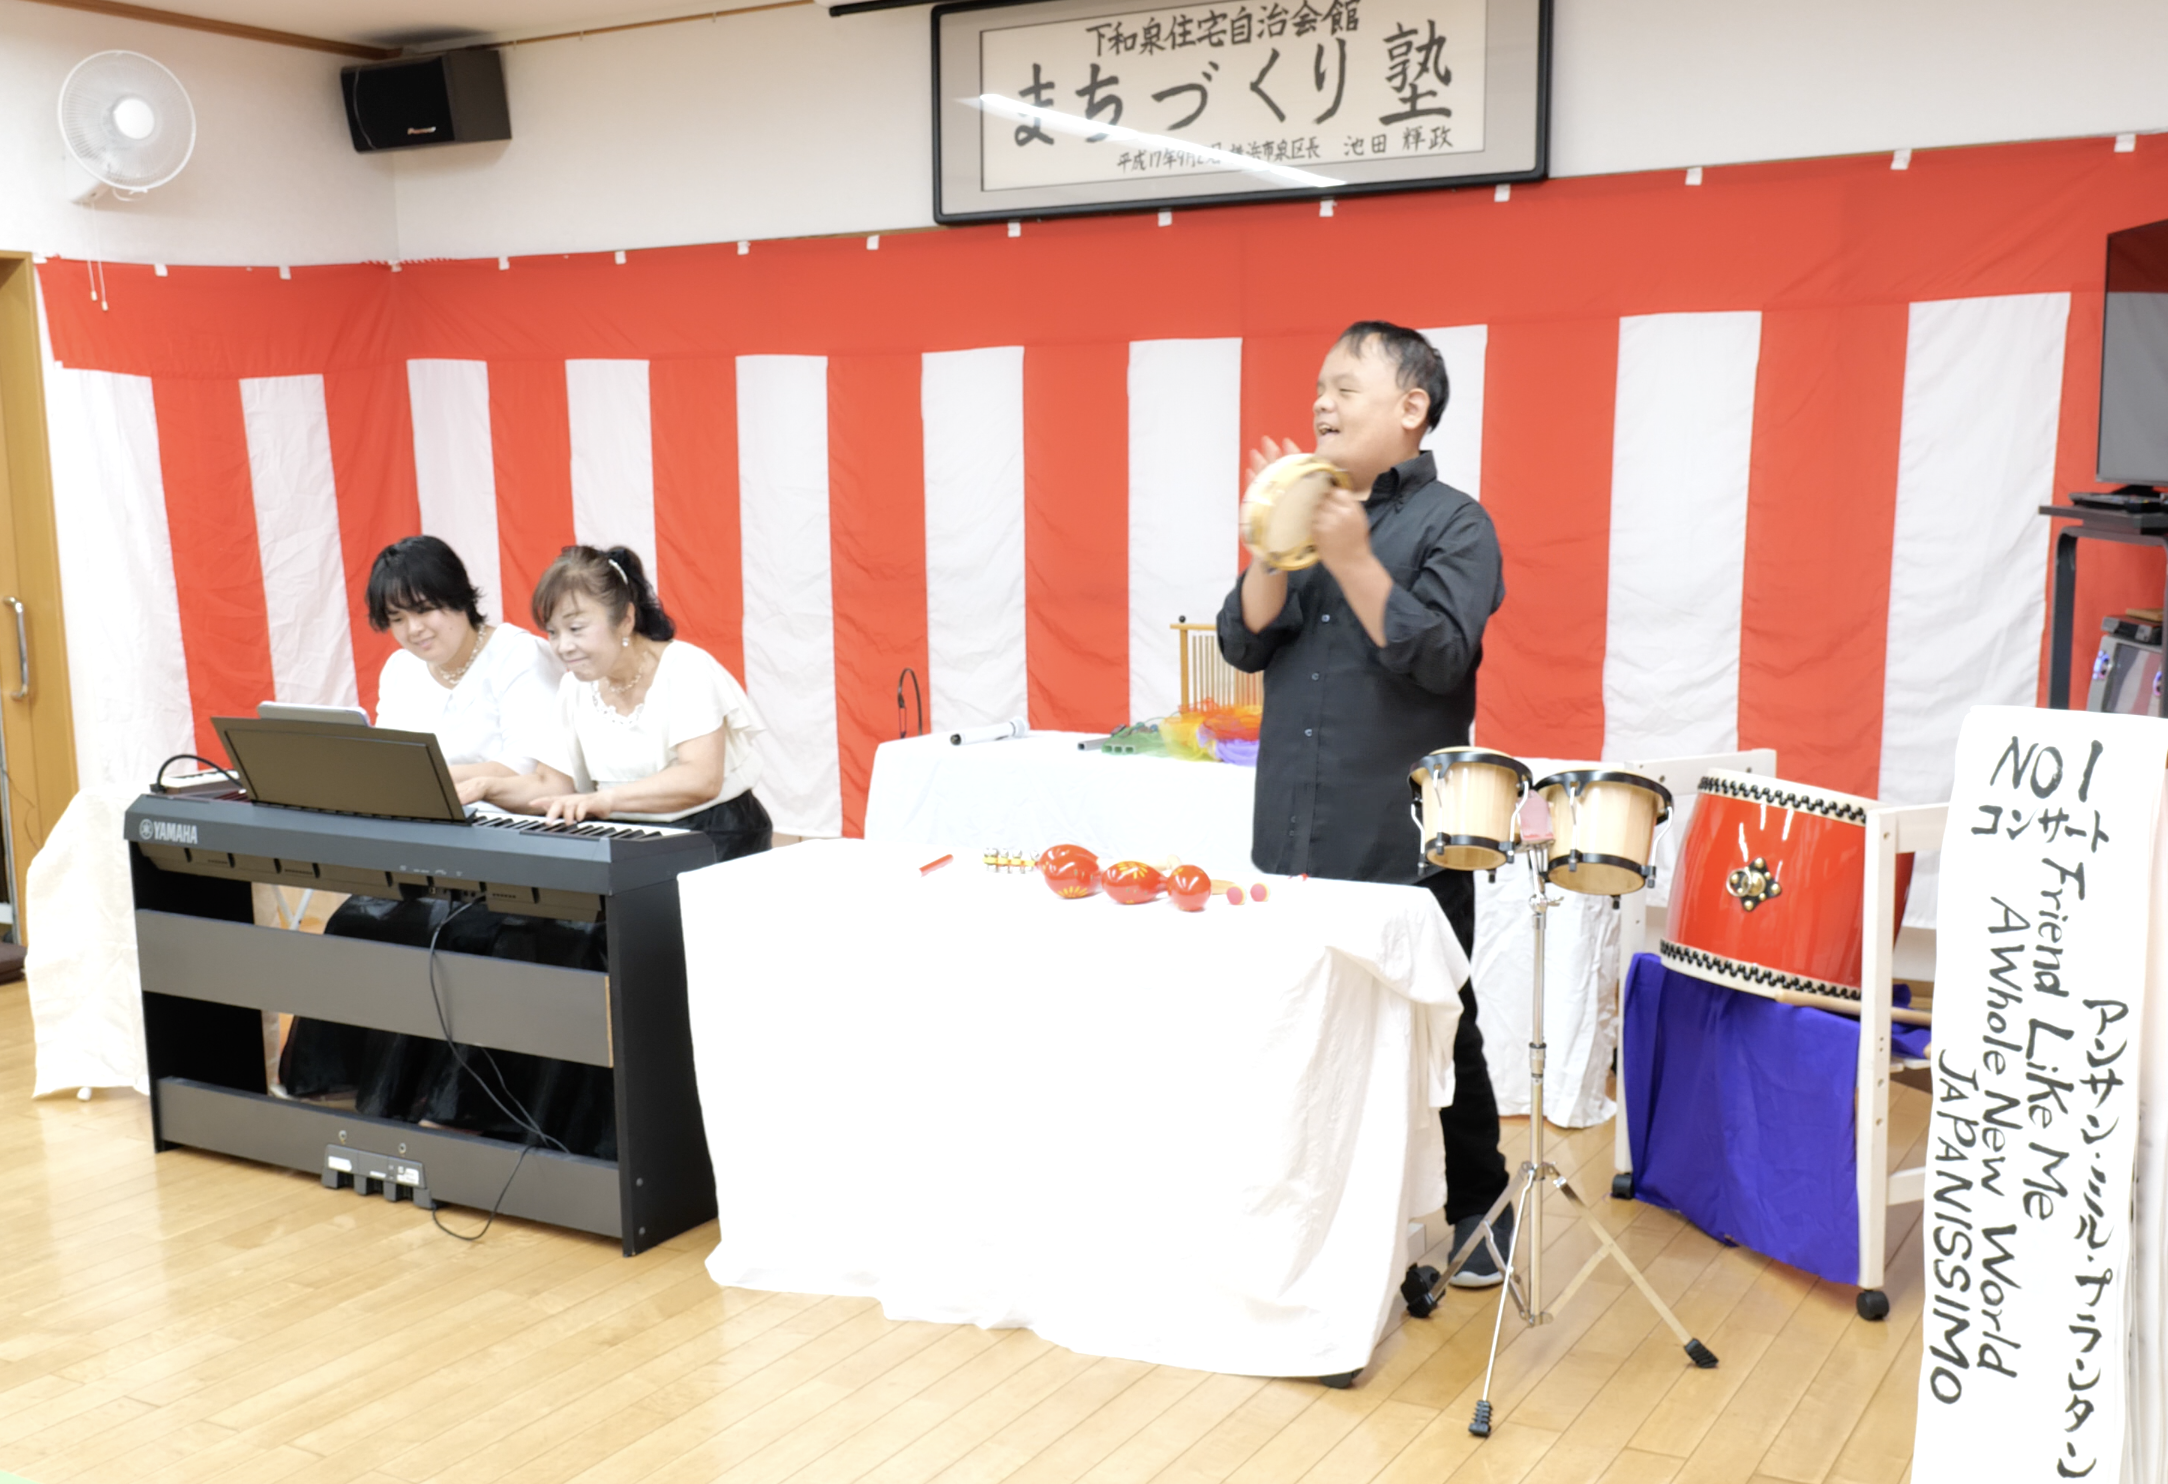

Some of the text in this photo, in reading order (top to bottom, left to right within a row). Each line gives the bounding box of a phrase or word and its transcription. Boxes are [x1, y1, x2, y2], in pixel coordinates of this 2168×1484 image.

[1014, 20, 1452, 146] まちづくり塾
[1085, 0, 1361, 57] 下和泉住宅自治会館
[153, 821, 198, 844] YAMAHA
[1971, 805, 2110, 853] コンサート
[2022, 858, 2086, 1221] Friend Like Me
[1981, 1090, 2023, 1197] New
[1930, 1049, 1980, 1405] JAPANISSIMO
[1976, 1224, 2022, 1378] World
